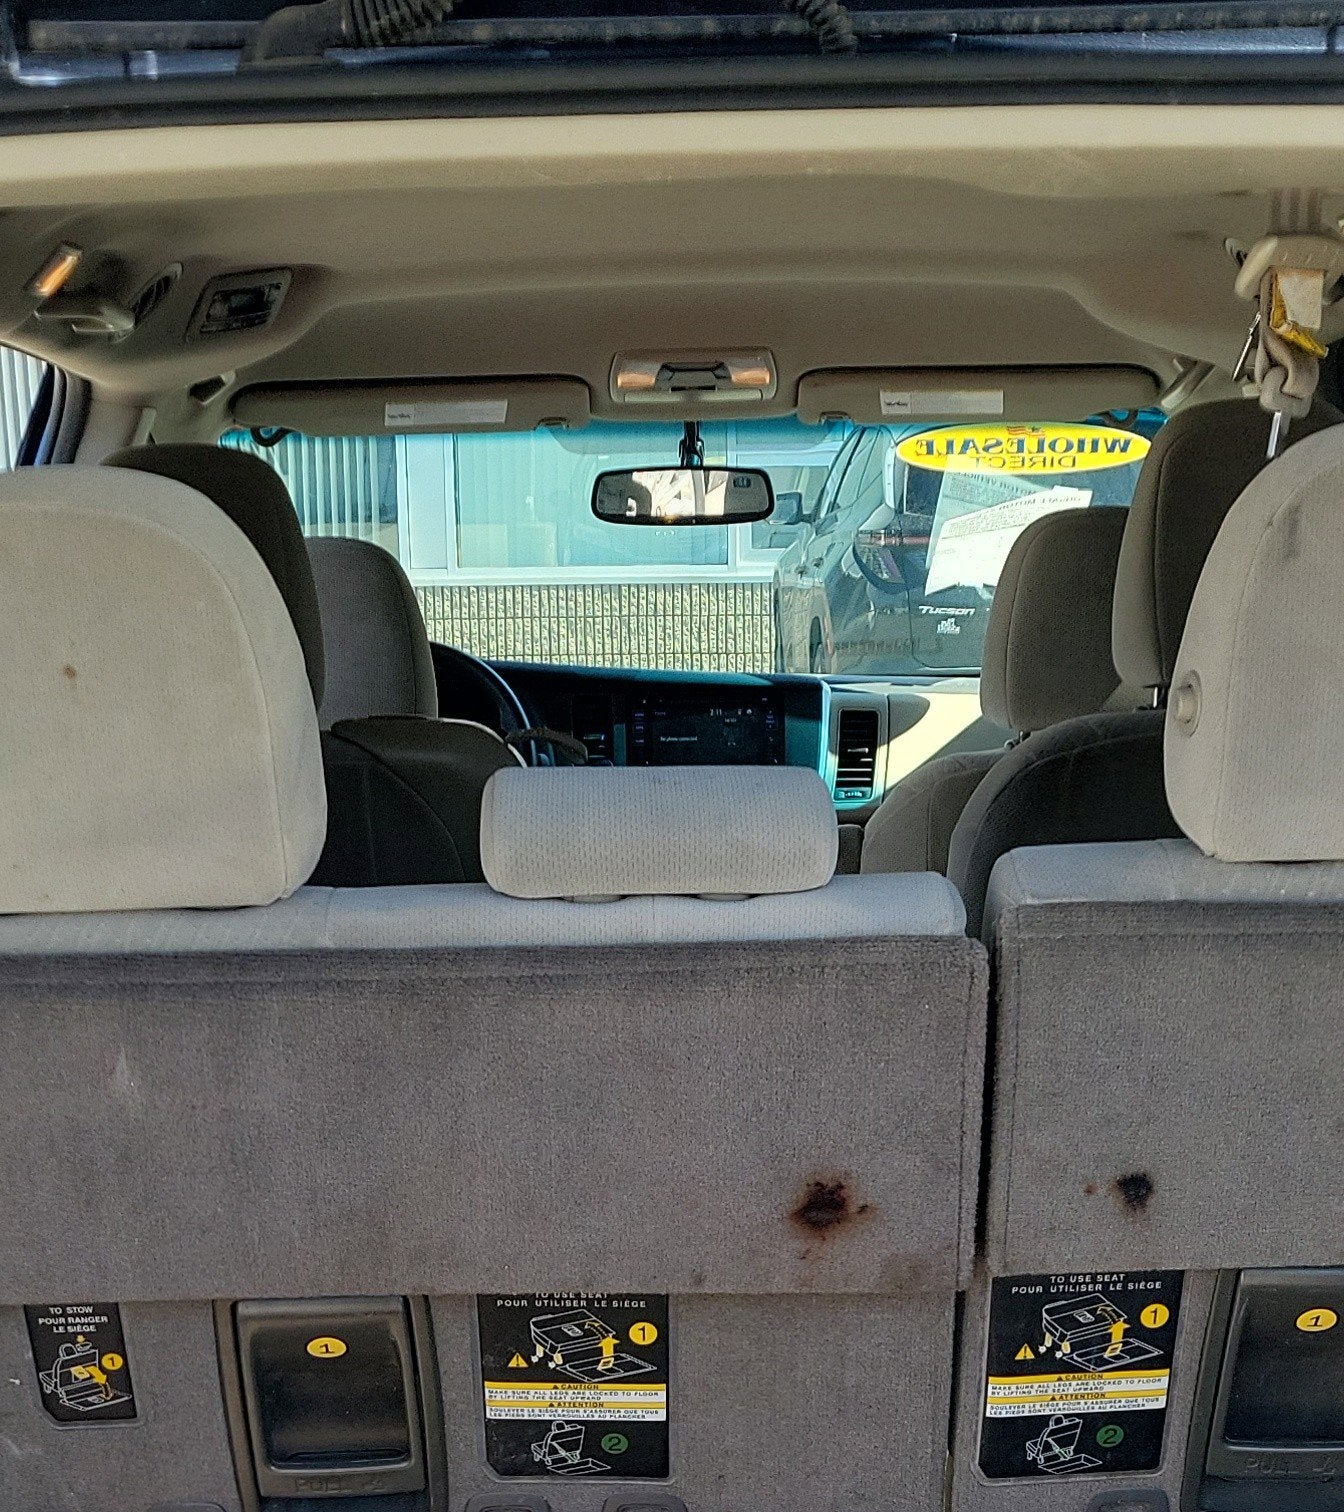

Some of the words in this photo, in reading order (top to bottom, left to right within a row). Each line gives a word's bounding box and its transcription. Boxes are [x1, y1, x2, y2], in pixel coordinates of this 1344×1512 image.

[1070, 1275, 1091, 1283] USE
[1097, 1274, 1126, 1282] SEAT
[1050, 1284, 1103, 1293] UTILISER
[66, 1306, 93, 1314] STOW
[39, 1317, 66, 1325] POUR
[68, 1316, 108, 1324] RANGER
[1103, 1428, 1118, 1444] 2
[608, 1436, 623, 1451] 2
